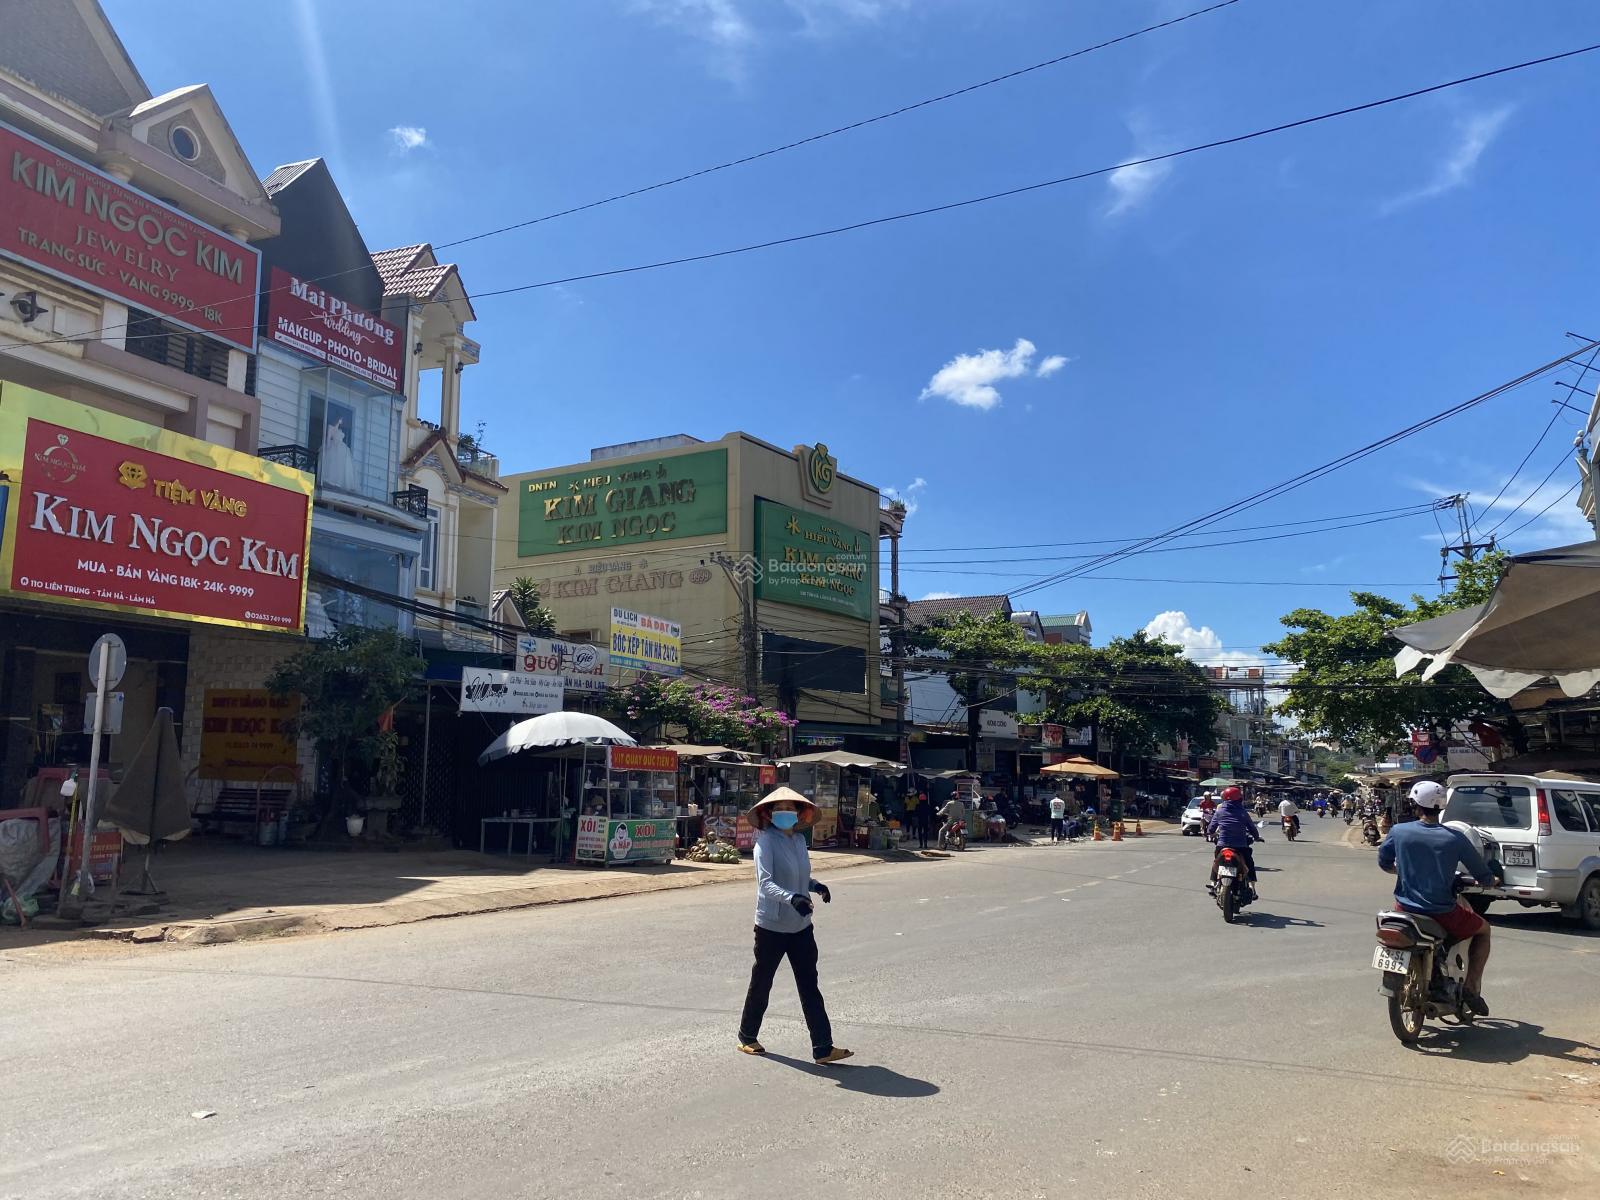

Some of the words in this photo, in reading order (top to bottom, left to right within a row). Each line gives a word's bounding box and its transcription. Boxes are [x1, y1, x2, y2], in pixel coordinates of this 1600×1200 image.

[12, 151, 76, 208] KIM
[84, 187, 188, 257] NGỌC
[195, 239, 243, 285] KIM
[74, 224, 181, 283] JEWELRY
[18, 227, 78, 264] TRANG
[161, 287, 195, 311] 9999
[203, 305, 224, 325] 18K
[289, 277, 326, 309] Mai
[329, 296, 394, 346] Phương
[278, 316, 322, 345] MAKEUP
[327, 339, 362, 364] PHOTO
[367, 356, 398, 381] BRIDAL
[528, 480, 557, 493] DNTN
[815, 458, 832, 481] KG
[153, 478, 197, 506] TIỆM
[200, 489, 248, 518] VÀNG
[543, 492, 598, 521] KIM
[605, 478, 697, 514] GIANG
[30, 491, 117, 544] KIM
[128, 513, 231, 567] NGỌC
[238, 536, 300, 580] KIM
[556, 520, 604, 545] KIM
[610, 511, 677, 540] NGỌC
[784, 546, 819, 567] KIM
[30, 579, 44, 588] 110
[44, 581, 63, 591] LIÊN
[64, 585, 91, 596] TRUNG
[77, 559, 107, 575] MUA
[116, 563, 142, 580] BÁN
[147, 569, 178, 586] VÀNG
[229, 584, 255, 598] 9999
[553, 577, 598, 599] KIM
[607, 570, 684, 594] GIANG
[625, 753, 643, 765] QUAY
[580, 818, 597, 833] XÔI
[1377, 958, 1404, 972] 6992
